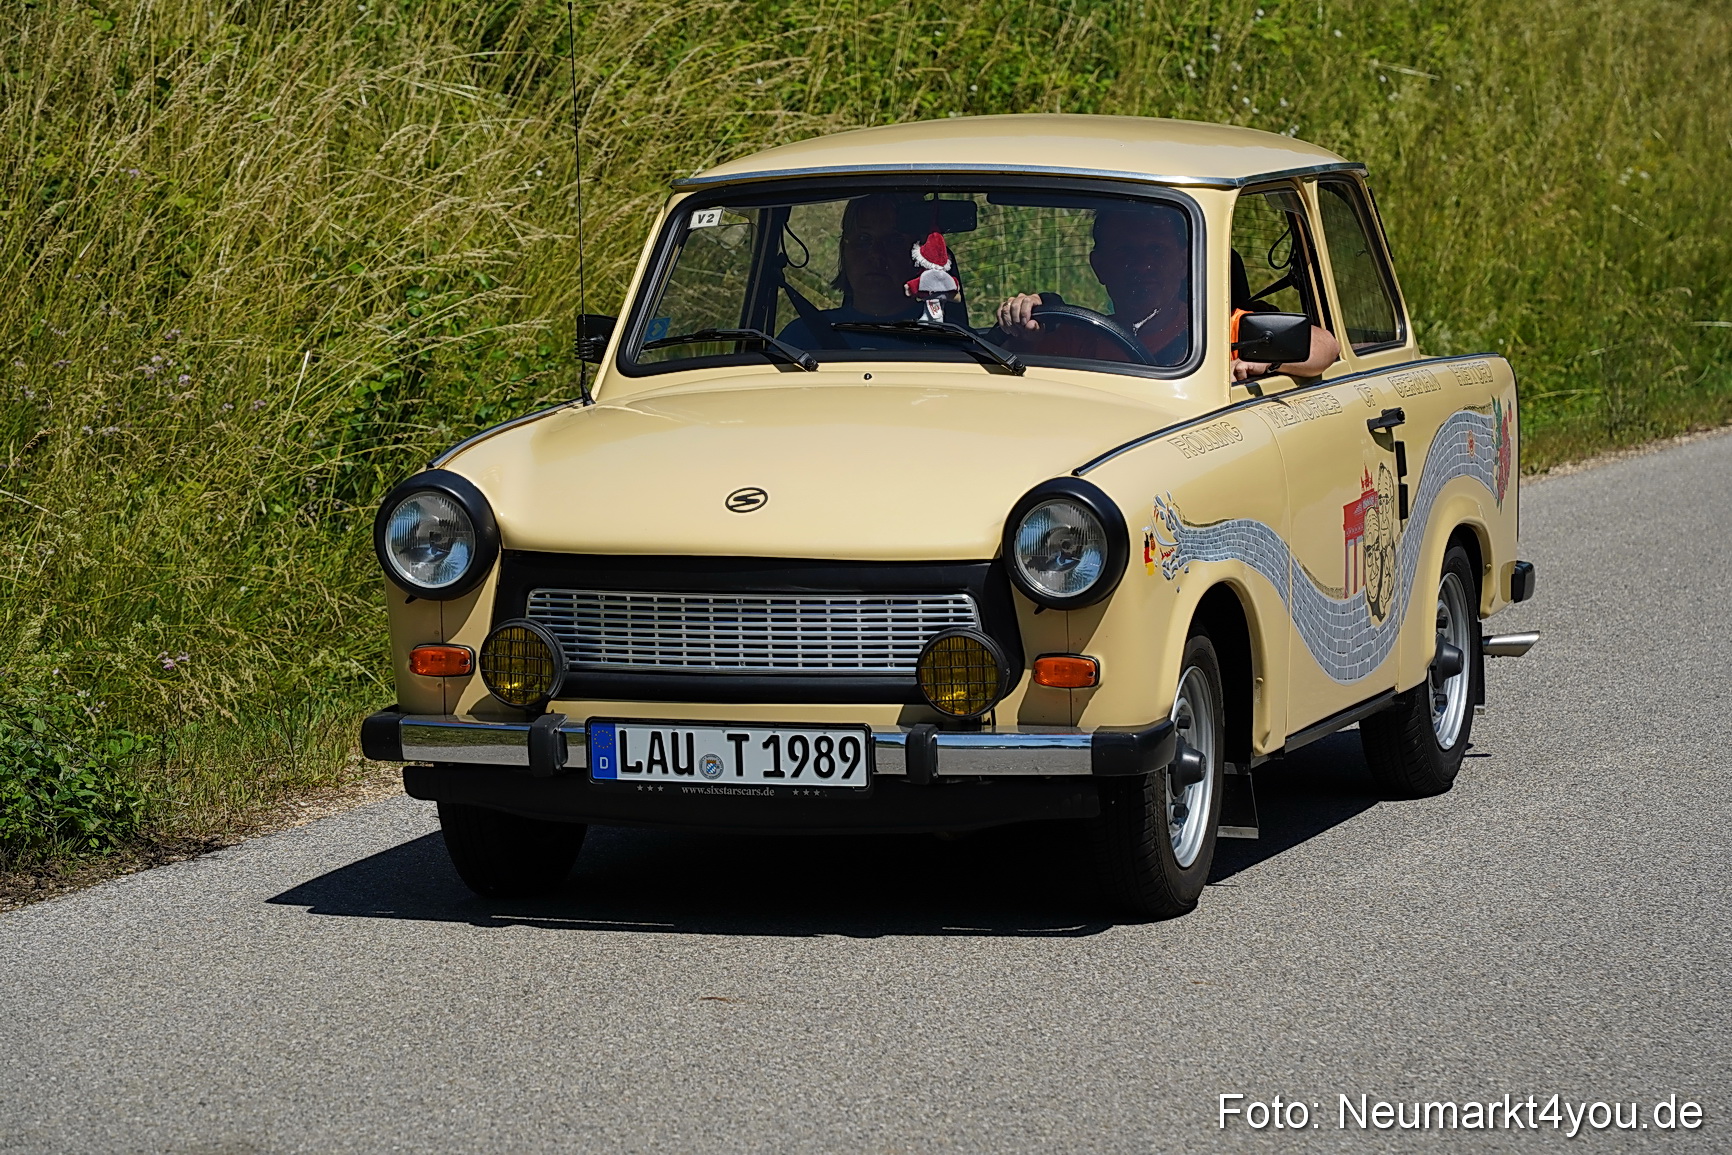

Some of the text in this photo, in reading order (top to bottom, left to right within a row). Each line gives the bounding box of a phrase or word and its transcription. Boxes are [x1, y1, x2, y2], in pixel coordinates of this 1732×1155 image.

[1167, 421, 1243, 459] ROLLING
[599, 757, 609, 770] D
[619, 729, 694, 776] LAU
[726, 733, 750, 777] T
[762, 733, 861, 780] 1989
[681, 785, 775, 797] www.sixstarscars.de
